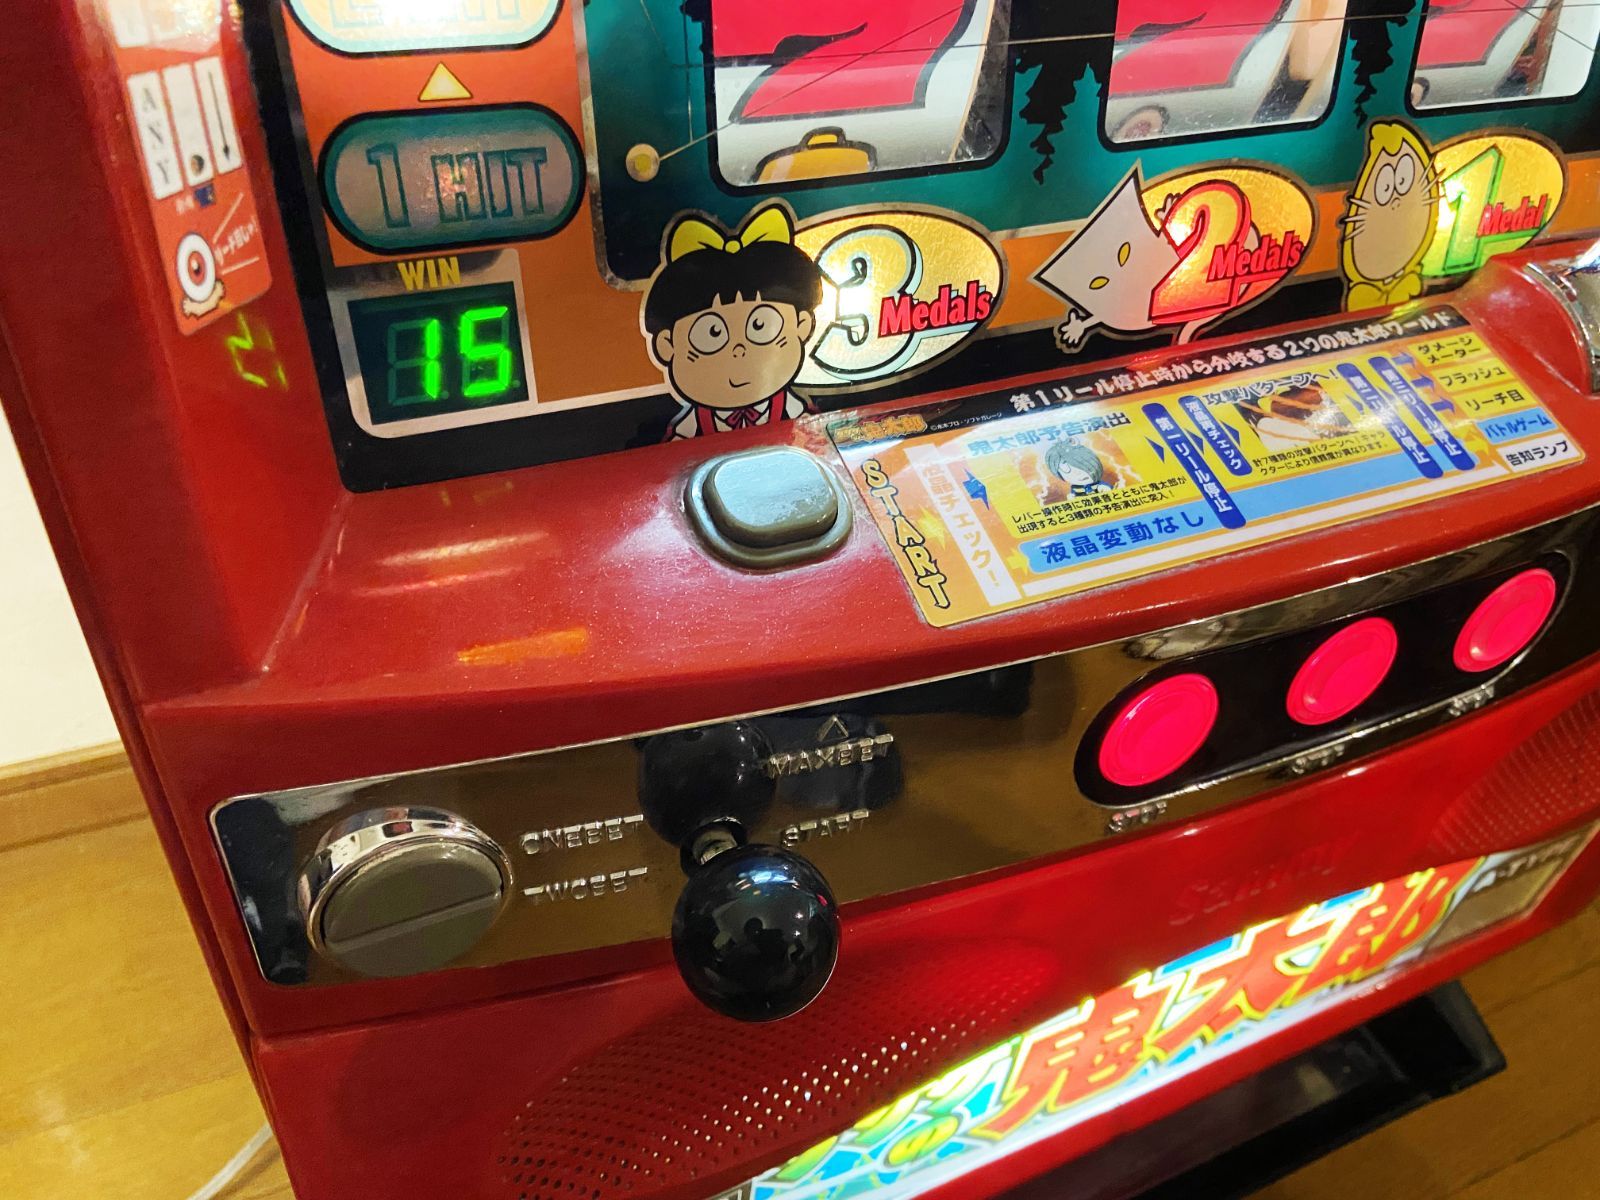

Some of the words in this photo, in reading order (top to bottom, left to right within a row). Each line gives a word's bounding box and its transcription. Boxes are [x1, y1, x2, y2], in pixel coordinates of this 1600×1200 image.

[366, 142, 411, 228] 1
[431, 147, 547, 223] HIT
[1432, 145, 1504, 275] 1
[1477, 193, 1547, 238] Medal
[398, 257, 461, 291] WIN
[1149, 178, 1253, 325] 2
[1206, 231, 1305, 284] Medals
[809, 223, 920, 381] 3
[878, 279, 993, 338] Medals
[424, 306, 512, 400] 15
[1439, 367, 1507, 386] フラッシュ
[1465, 388, 1526, 411] リーチ目
[1484, 413, 1552, 438] バトルゲーム
[968, 411, 1131, 457] 鬼太郎予告演出
[1505, 440, 1569, 466] 告知ランプ
[1156, 417, 1232, 512] 第一リール停止
[861, 458, 950, 609] START
[1040, 509, 1204, 564] 液晶変動なし
[519, 813, 644, 855] ONEBET
